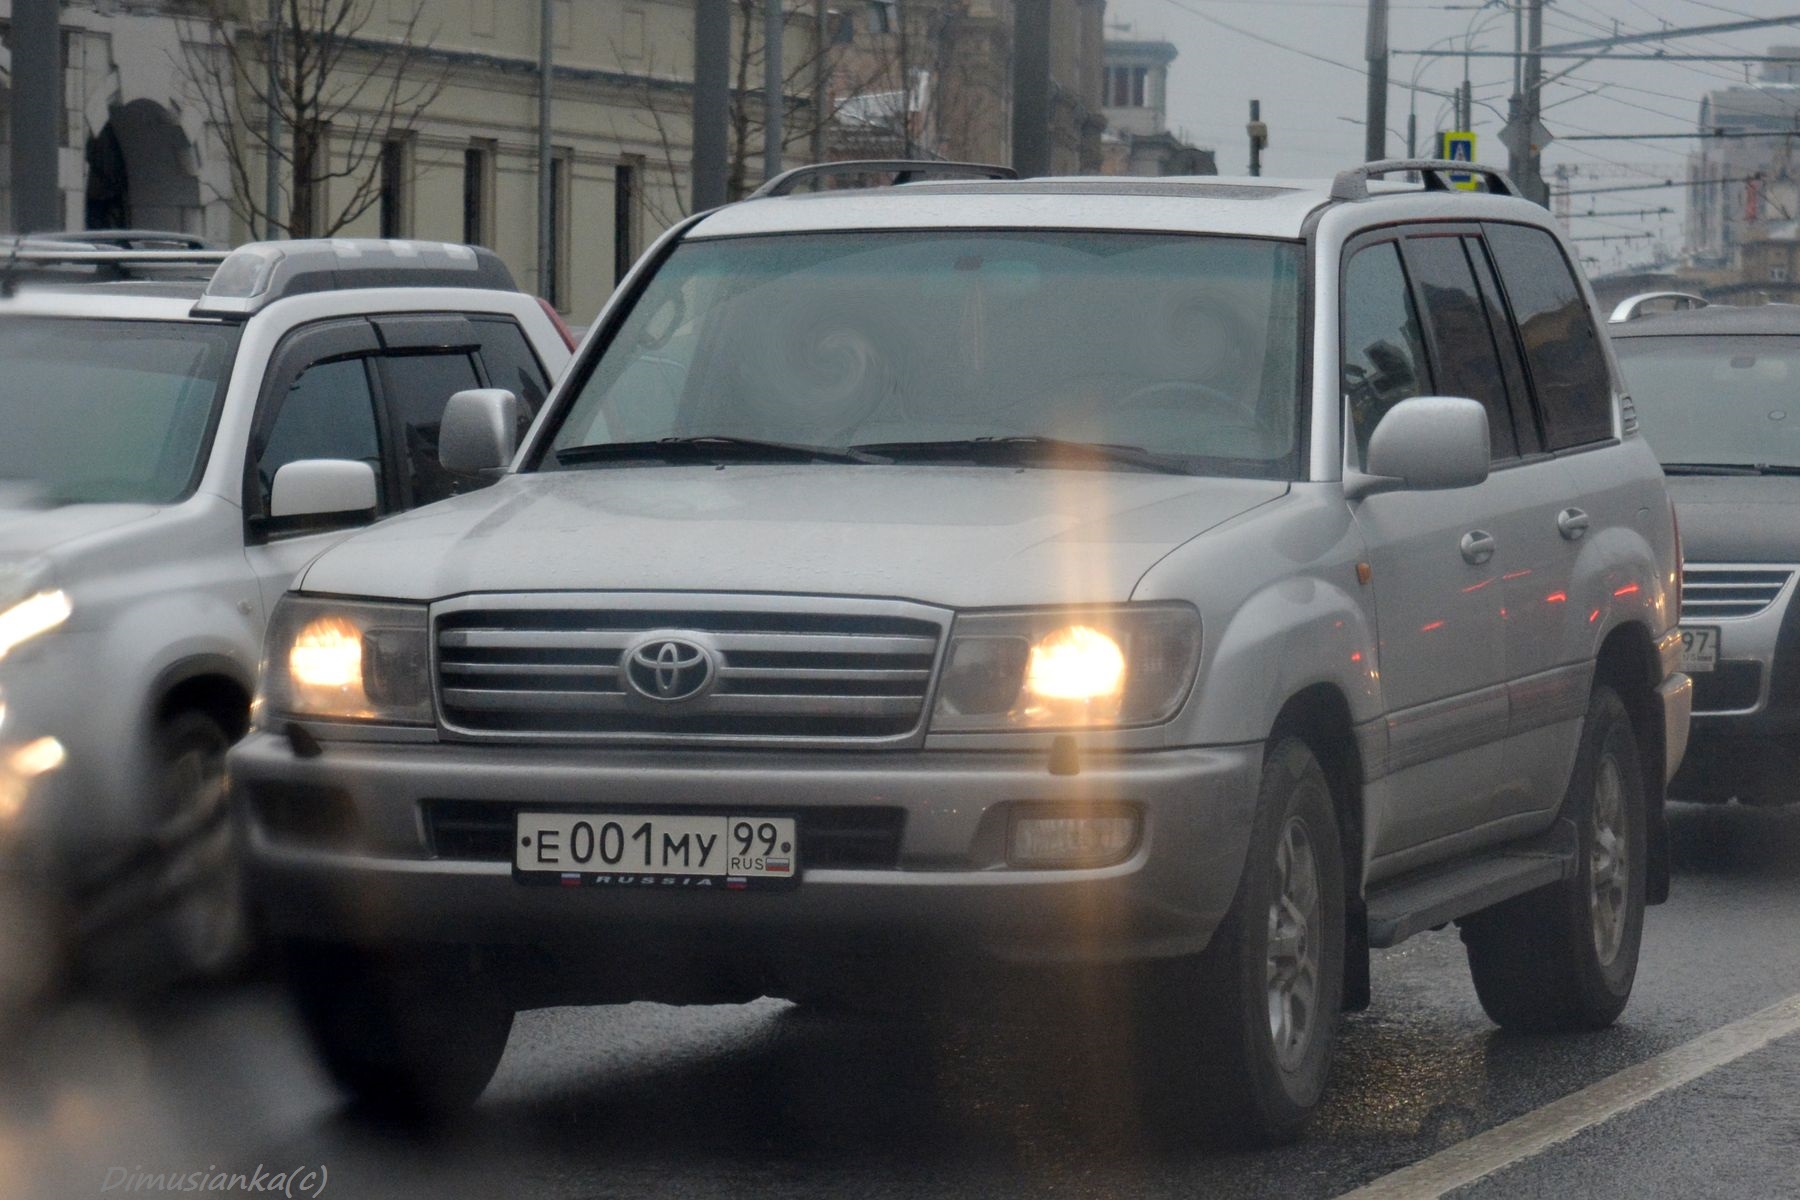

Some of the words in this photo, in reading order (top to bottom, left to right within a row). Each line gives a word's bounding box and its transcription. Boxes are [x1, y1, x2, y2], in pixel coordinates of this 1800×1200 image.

[1681, 631, 1709, 653] 97
[733, 822, 777, 856] 99
[731, 857, 763, 870] RUS
[596, 876, 712, 886] RUSSIA
